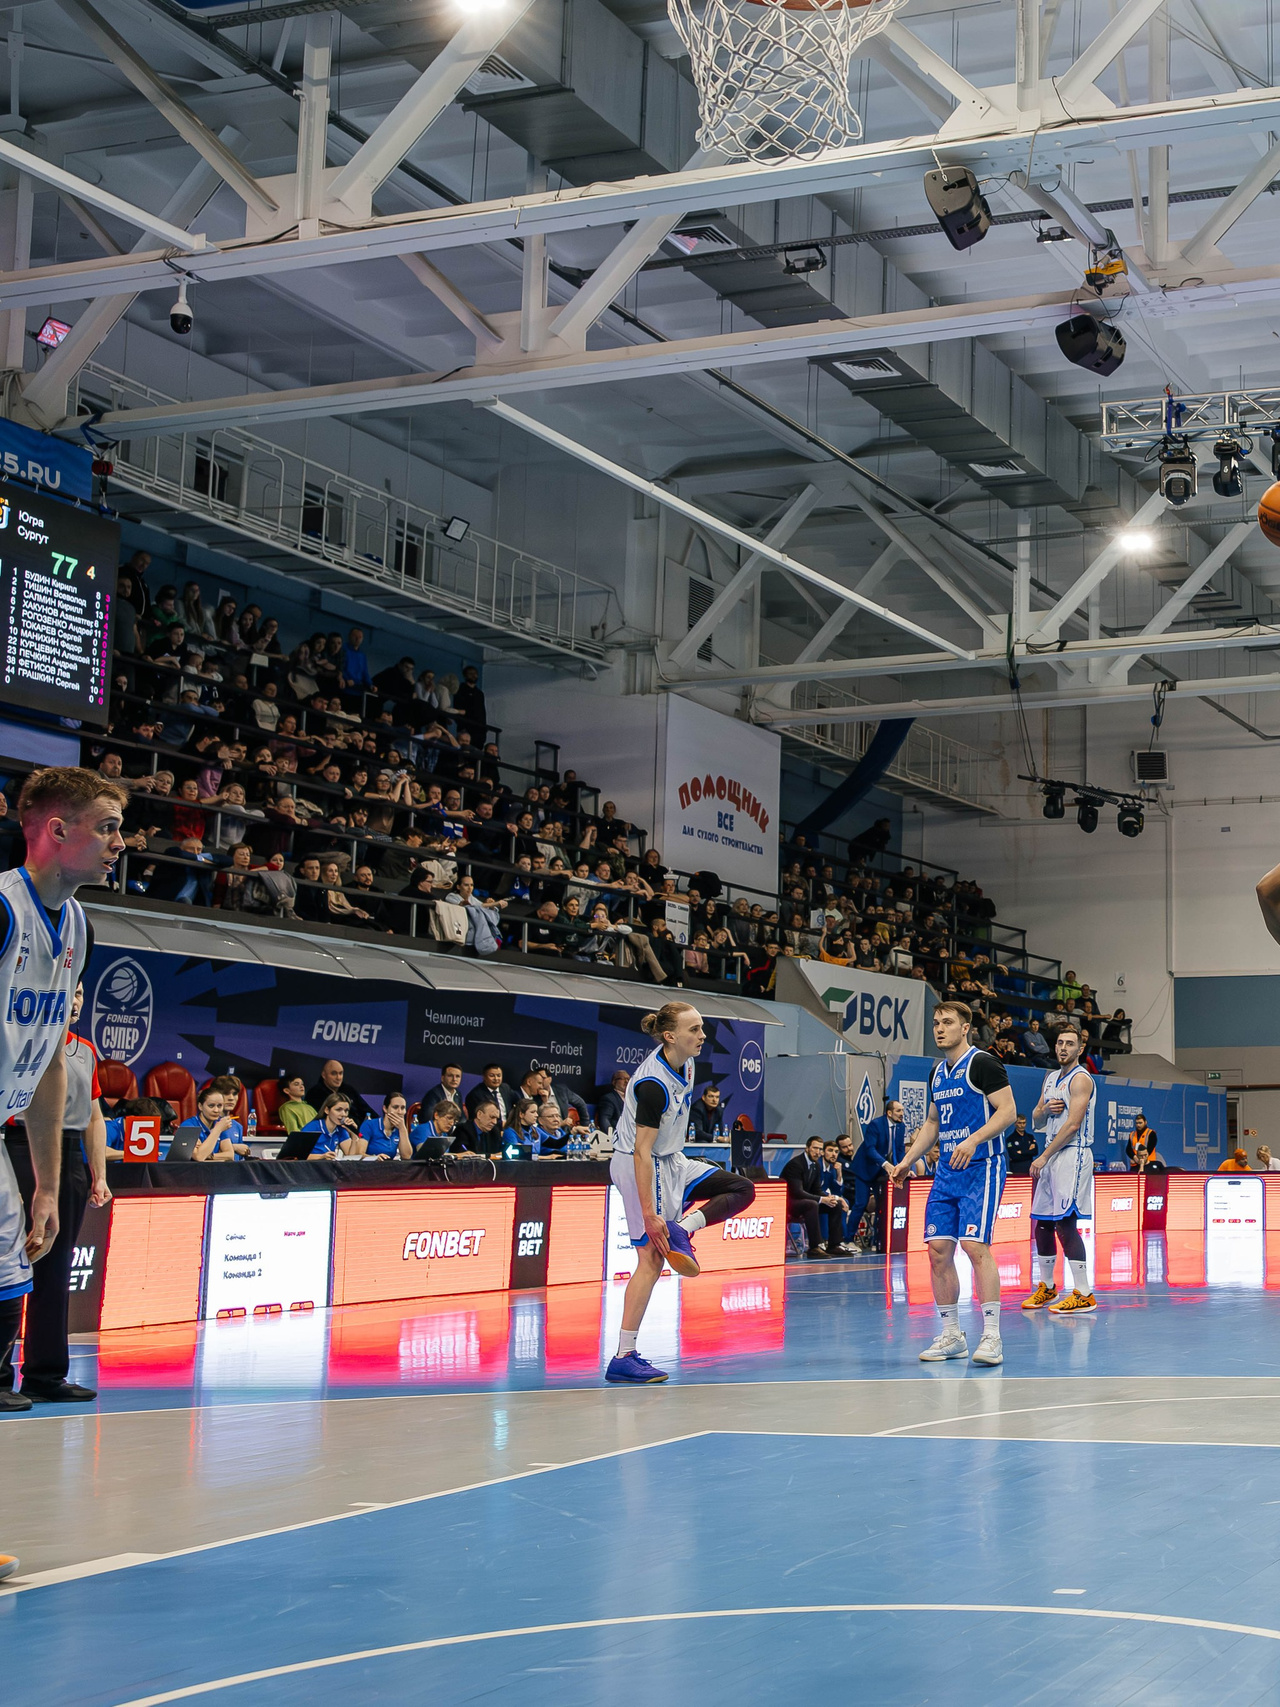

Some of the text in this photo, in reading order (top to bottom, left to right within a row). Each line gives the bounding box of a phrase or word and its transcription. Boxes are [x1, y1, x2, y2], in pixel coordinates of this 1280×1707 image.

[0, 452, 60, 489] 5.RU
[19, 510, 44, 528] Югра
[17, 525, 49, 544] Сургут
[51, 552, 96, 580] 77 4
[25, 570, 50, 584] БУДИН
[24, 580, 52, 595] ТИШИН
[23, 590, 56, 606] САЛМИН
[23, 600, 58, 616] ХАКУНОВ
[21, 619, 56, 635] ТОКАРЕВ
[22, 609, 67, 629] РОГОЗЕНКО
[20, 629, 59, 646] МАНИХИН
[19, 648, 50, 664] ПЕЧКИН
[20, 639, 60, 656] КУРЦЕВИЧ
[19, 658, 56, 675] ФЕТИСОВ
[18, 668, 54, 684] ГРАШКИН
[678, 774, 769, 833] ПОМОЩНИК
[717, 811, 734, 832] ВСЕ
[682, 825, 763, 855] ДЛЯ СУХОГО СТРОИТЕЛЬСТВА
[1117, 976, 1124, 986] 6
[106, 1013, 139, 1024] FONBET
[425, 1009, 484, 1027] Чемпионат
[860, 992, 910, 1041] ВСК
[102, 1025, 139, 1050] СУПЕР
[312, 1020, 382, 1044] FONBET
[423, 1030, 582, 1056] России Fonbet
[12, 1039, 48, 1078] 44
[742, 1059, 760, 1073] РФБ
[941, 1103, 953, 1124] 27
[129, 1121, 154, 1156] 5
[518, 1222, 543, 1238] FON
[723, 1217, 774, 1240] FONBET
[893, 1218, 906, 1229] BET
[403, 1229, 485, 1259] FONBET
[518, 1239, 542, 1256] BET
[224, 1253, 257, 1262] Команда
[68, 1270, 93, 1290] ET
[223, 1269, 256, 1279] Команда
